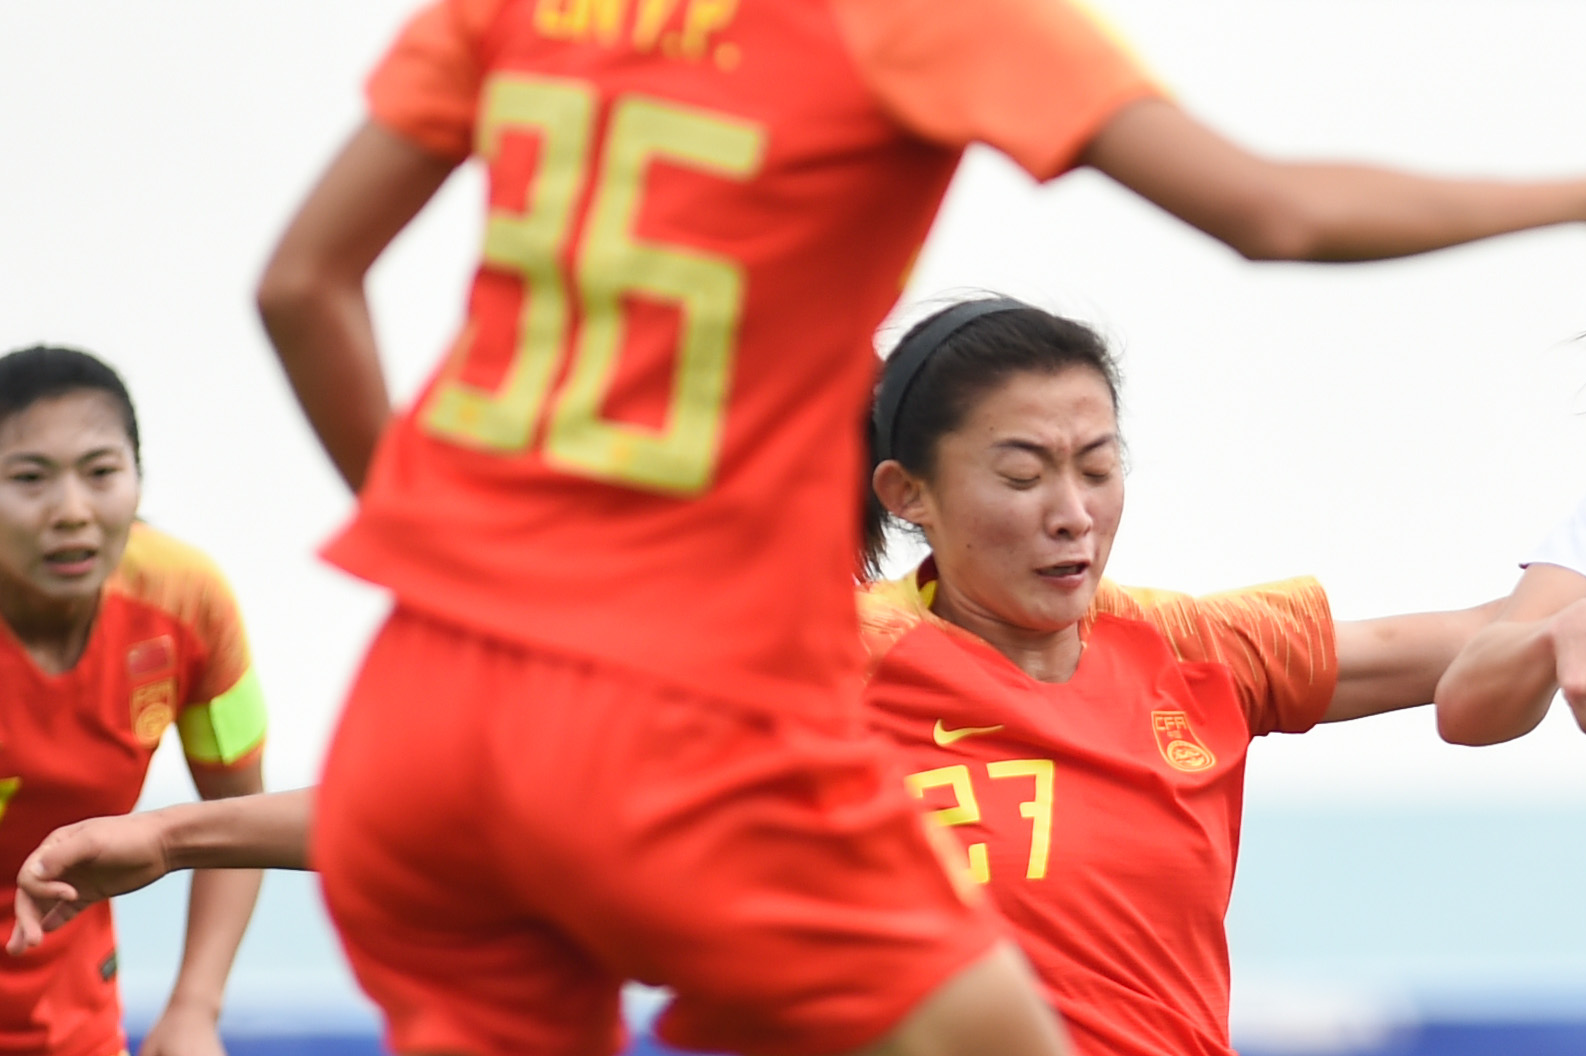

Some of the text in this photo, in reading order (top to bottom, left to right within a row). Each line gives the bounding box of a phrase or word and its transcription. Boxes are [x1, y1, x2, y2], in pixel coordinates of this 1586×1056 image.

[416, 70, 768, 500] 36
[1155, 716, 1188, 731] CFA
[903, 758, 1055, 889] 27
